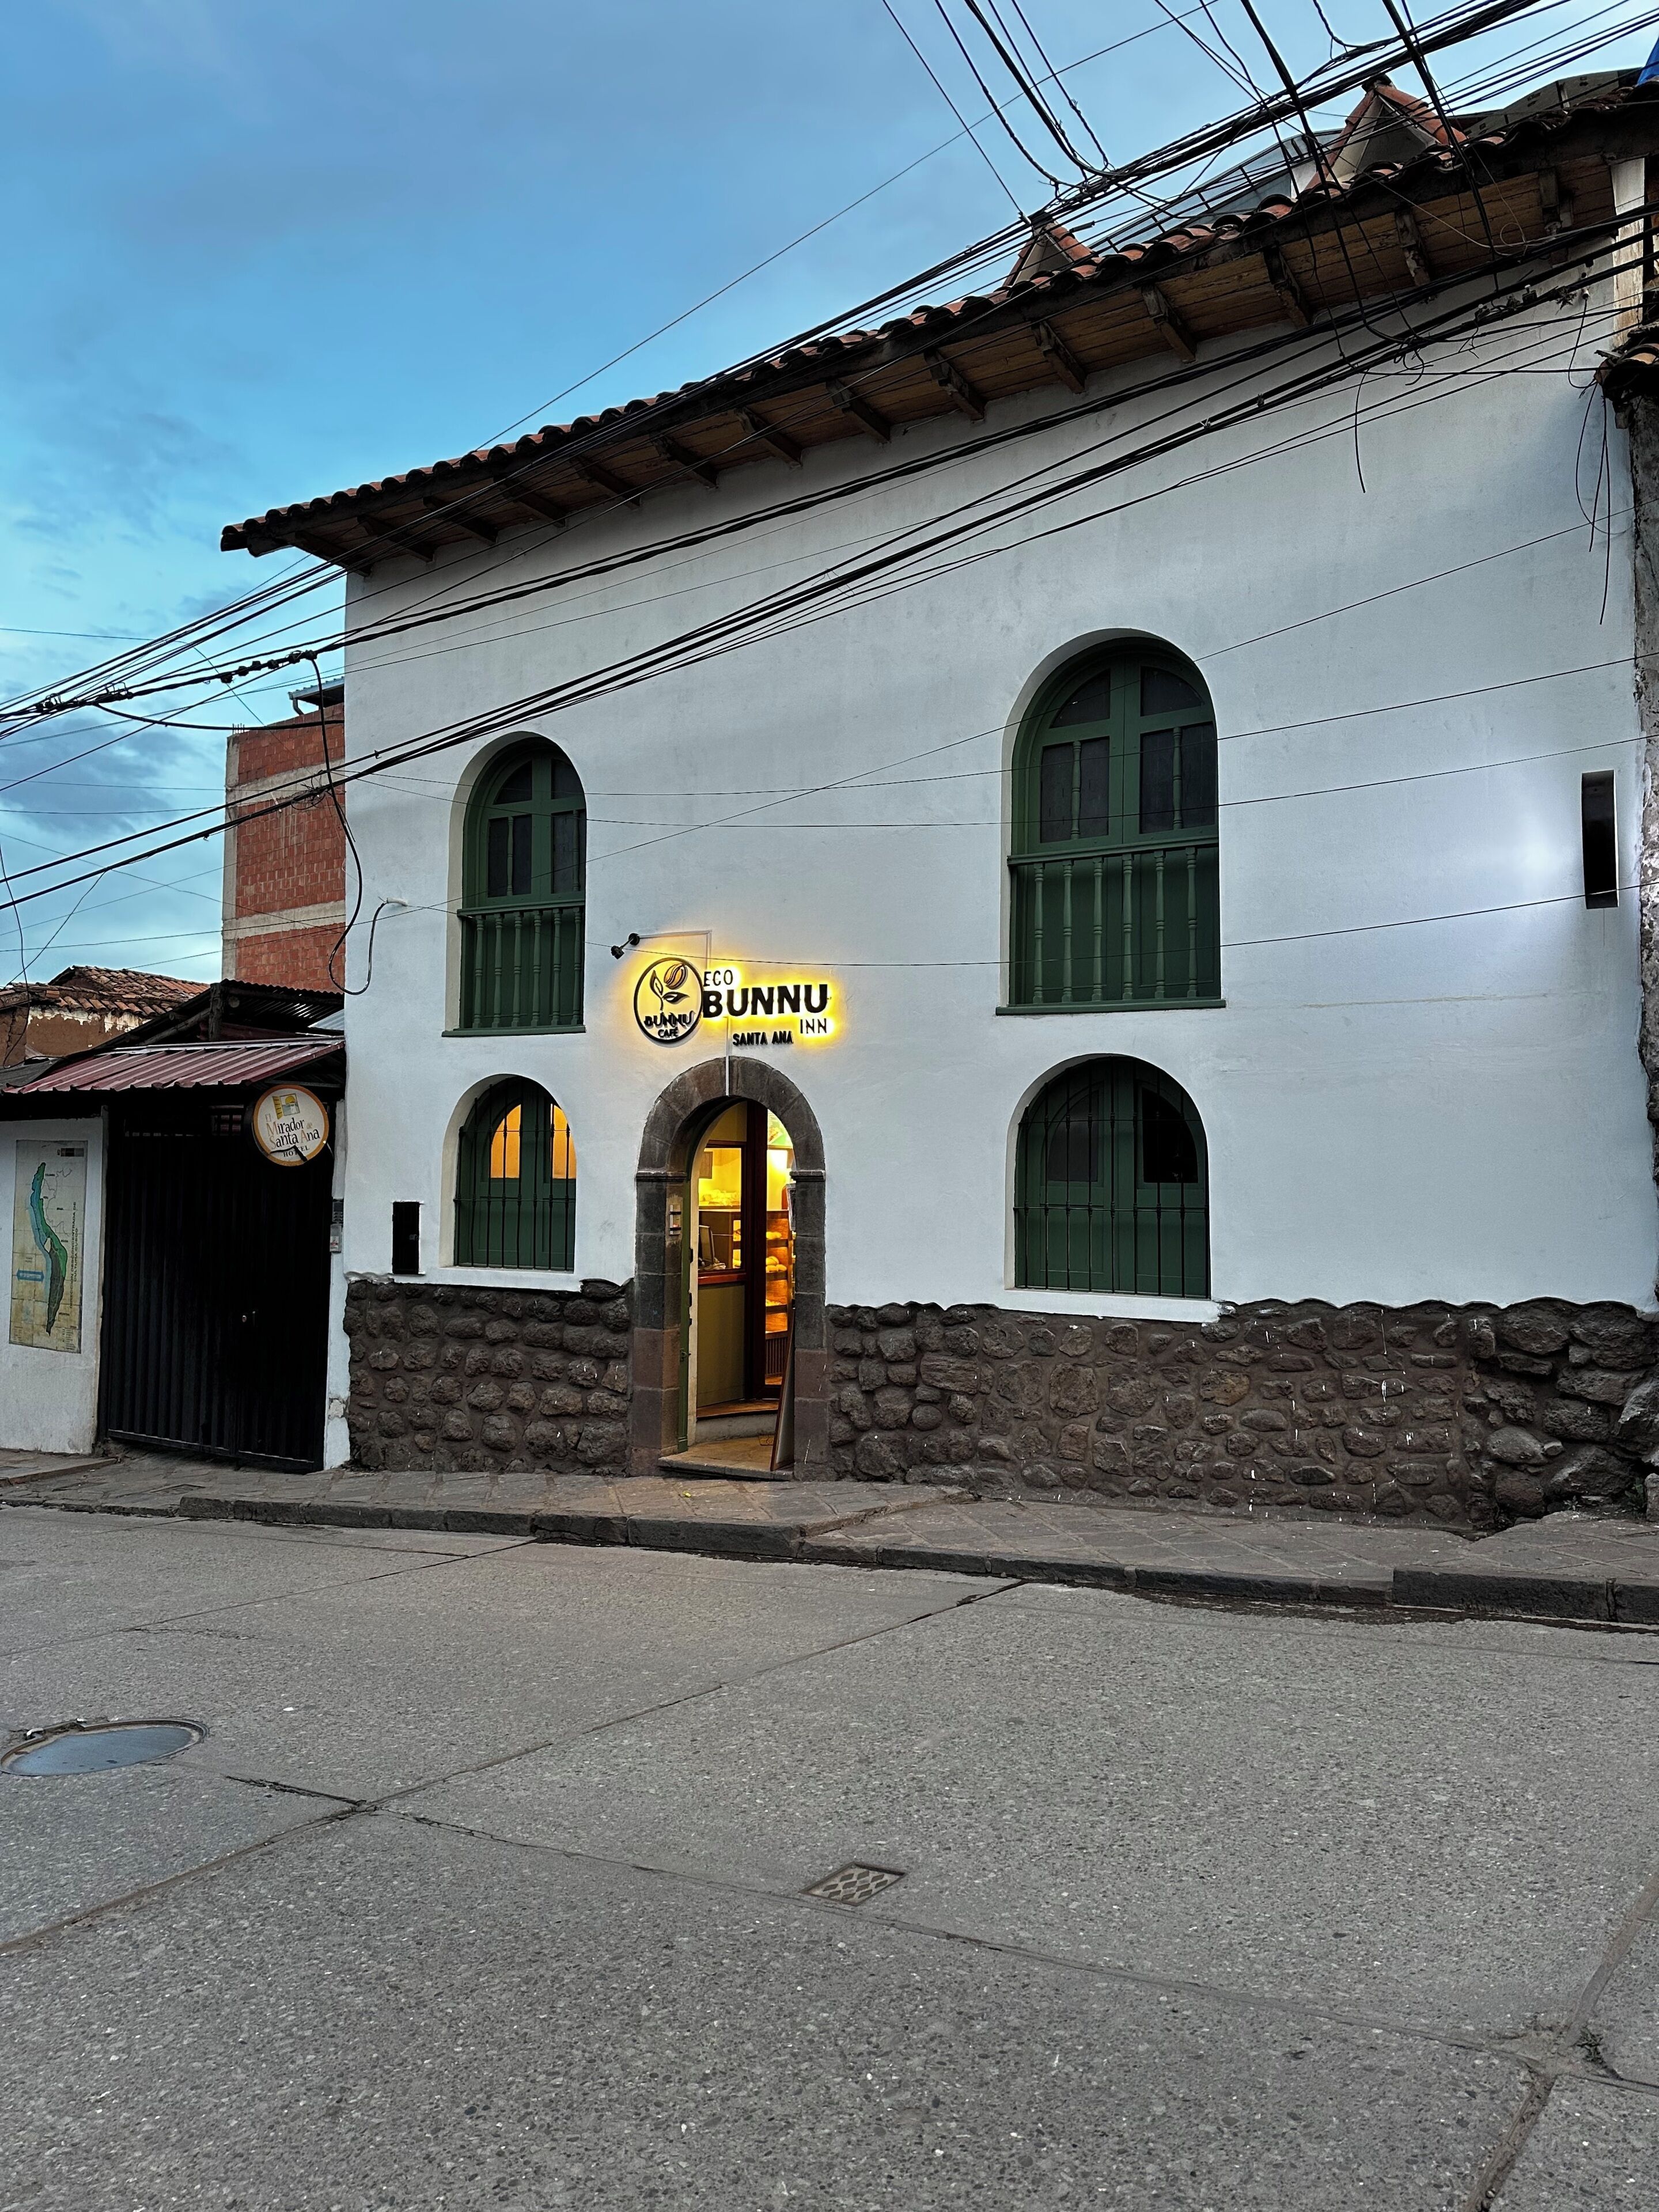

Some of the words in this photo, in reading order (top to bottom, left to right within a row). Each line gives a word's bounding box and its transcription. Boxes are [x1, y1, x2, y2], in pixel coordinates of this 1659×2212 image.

[703, 969, 733, 986] ECO
[703, 984, 828, 1018] BUNNU
[643, 1010, 695, 1028] BUNNU
[800, 1018, 827, 1033] INN
[732, 1032, 768, 1046] SANTA
[771, 1031, 794, 1044] ANA
[266, 1118, 305, 1137] Mirador
[269, 1133, 299, 1149] Santa
[301, 1128, 320, 1143] Ana
